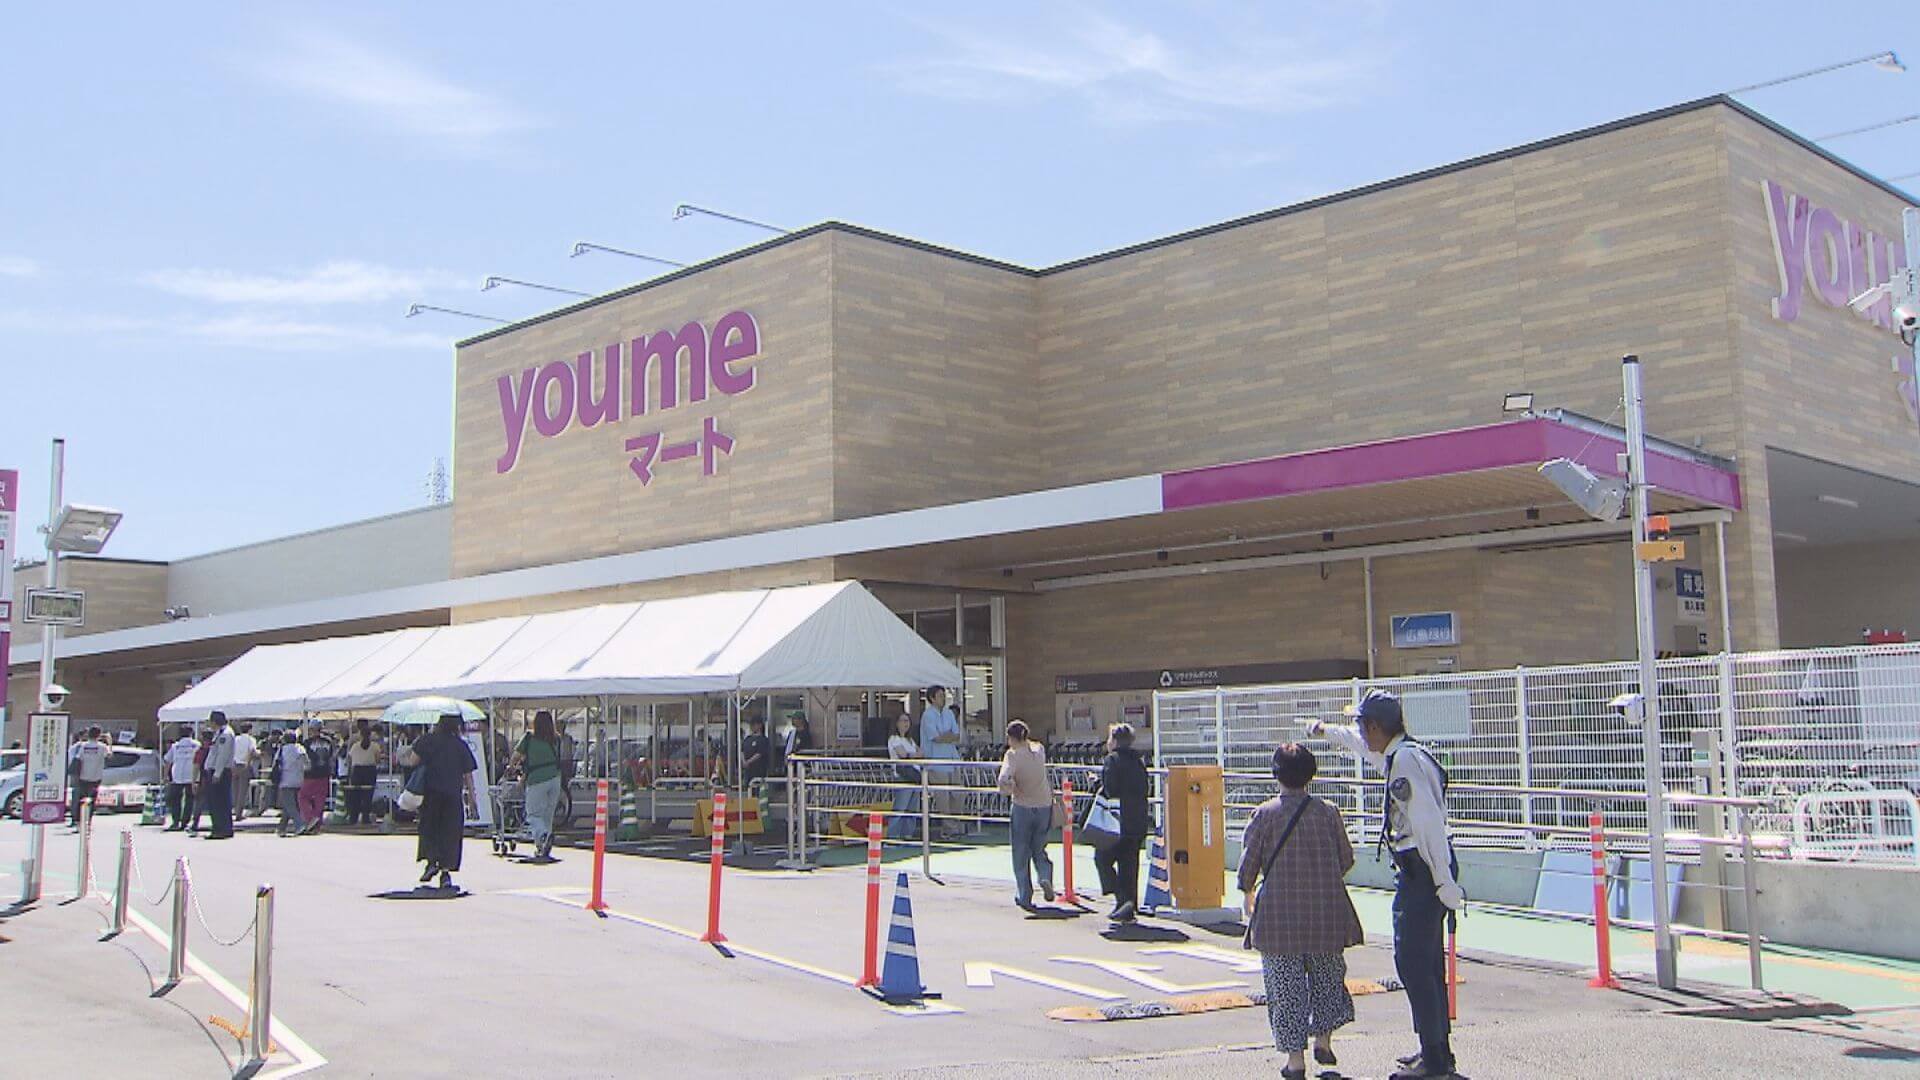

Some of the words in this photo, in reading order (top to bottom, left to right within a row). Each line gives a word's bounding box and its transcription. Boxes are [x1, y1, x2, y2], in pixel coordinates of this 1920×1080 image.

[497, 310, 761, 475] youme
[625, 416, 736, 486] マート
